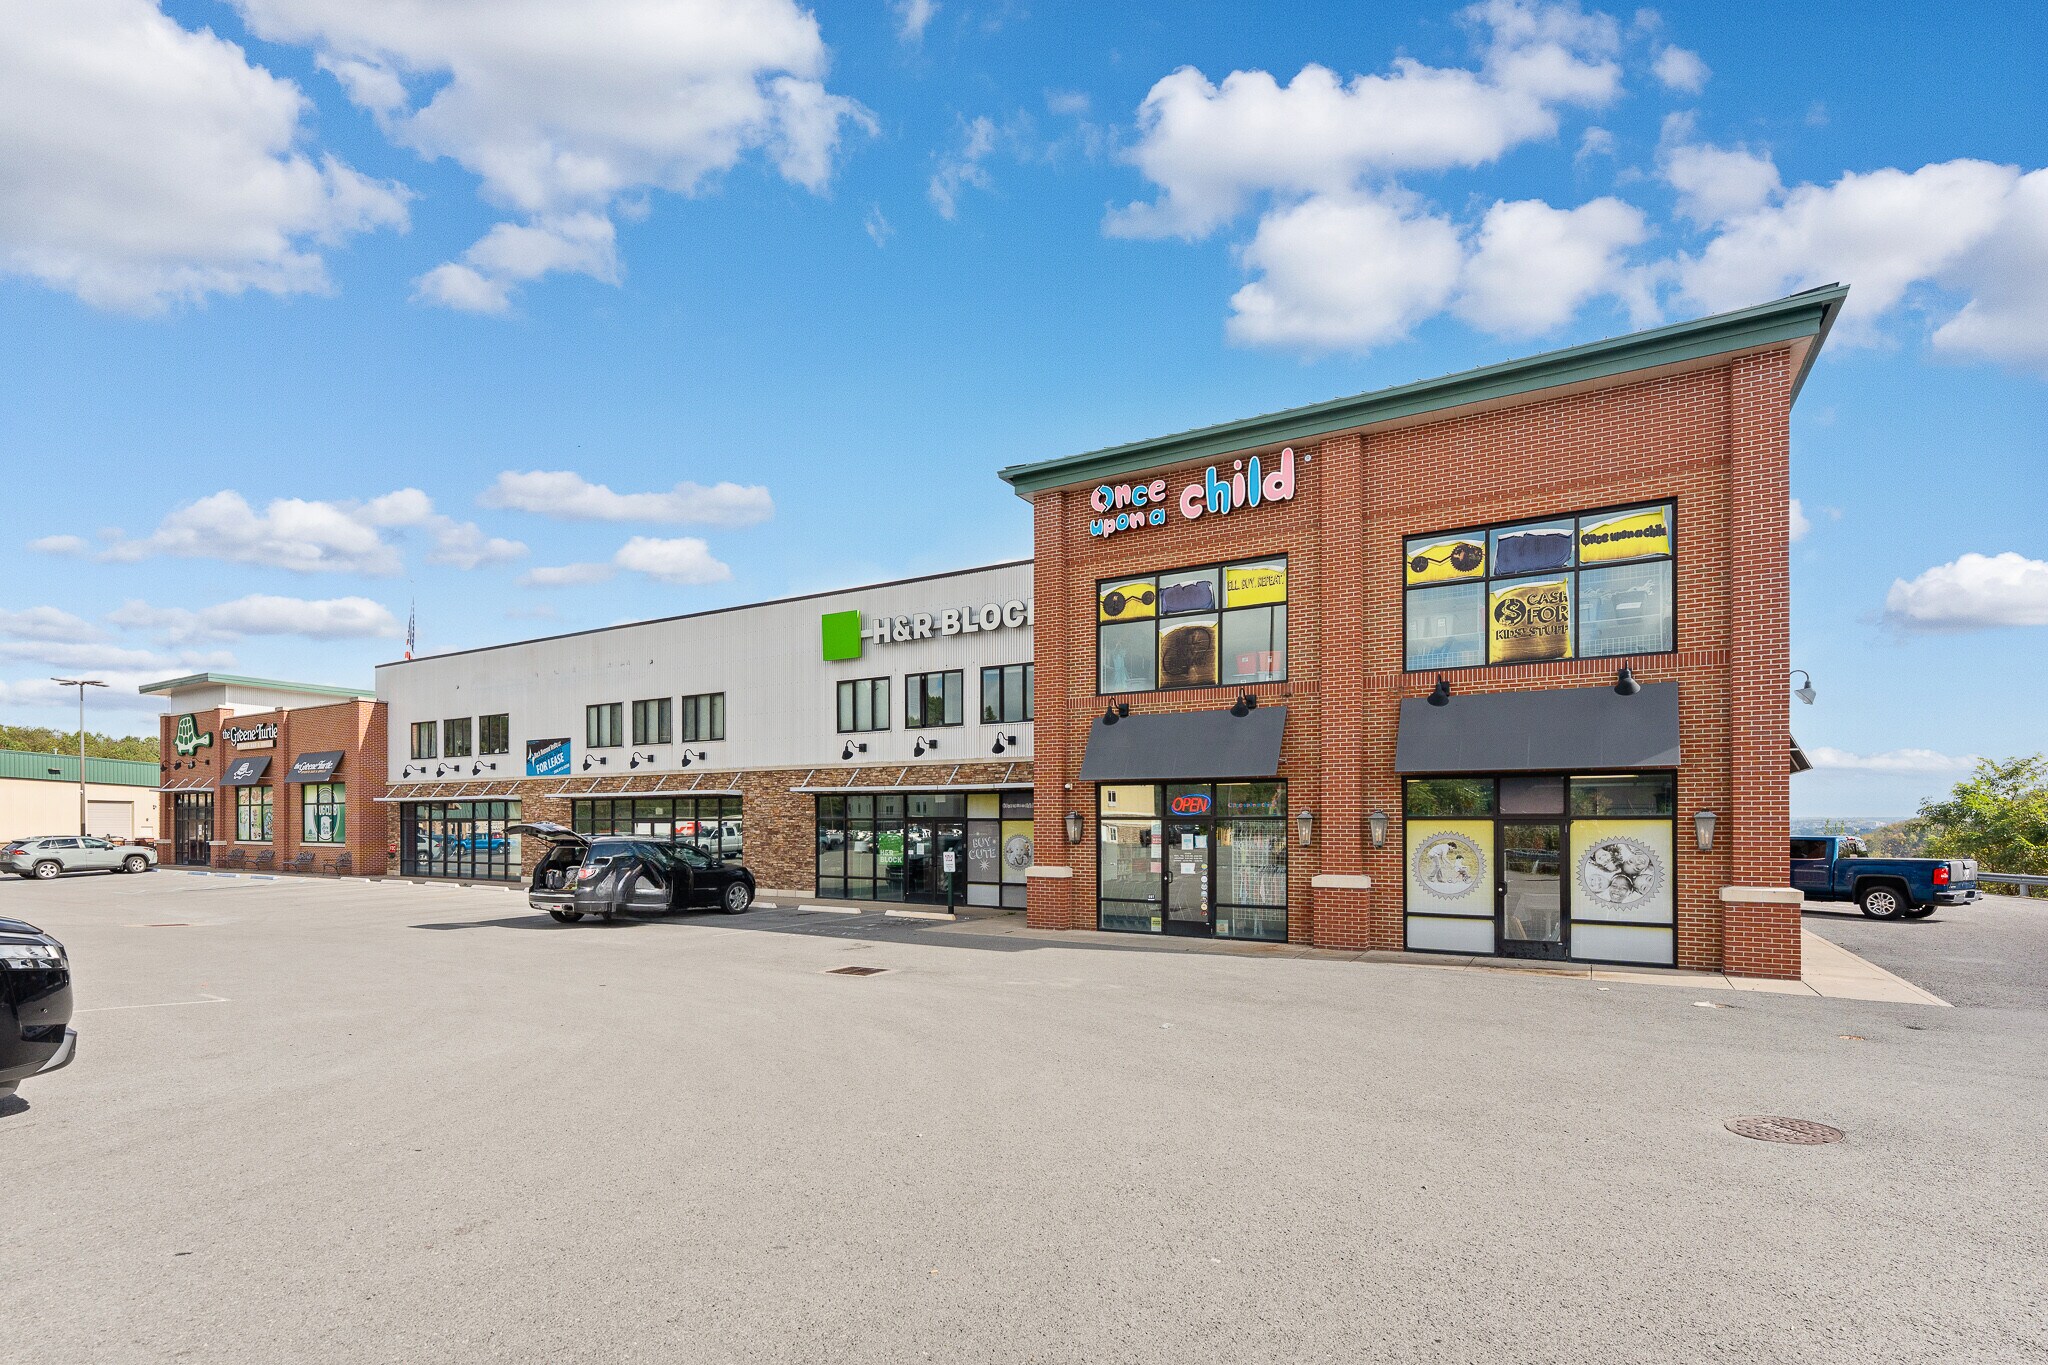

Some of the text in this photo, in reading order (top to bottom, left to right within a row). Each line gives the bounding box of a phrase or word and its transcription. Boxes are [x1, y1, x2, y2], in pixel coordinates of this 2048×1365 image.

[1179, 447, 1296, 519] child
[1090, 479, 1167, 514] Once
[1089, 507, 1166, 538] upon a
[1527, 591, 1568, 605] CASH
[1527, 605, 1568, 625] FOR
[873, 612, 934, 644] H&R
[222, 729, 231, 739] the
[230, 726, 257, 746] Greene
[255, 723, 278, 739] Turtle
[536, 761, 548, 774] FOR
[547, 752, 564, 768] LEASE
[1171, 797, 1208, 813] OPEN
[880, 856, 902, 864] BLOCK
